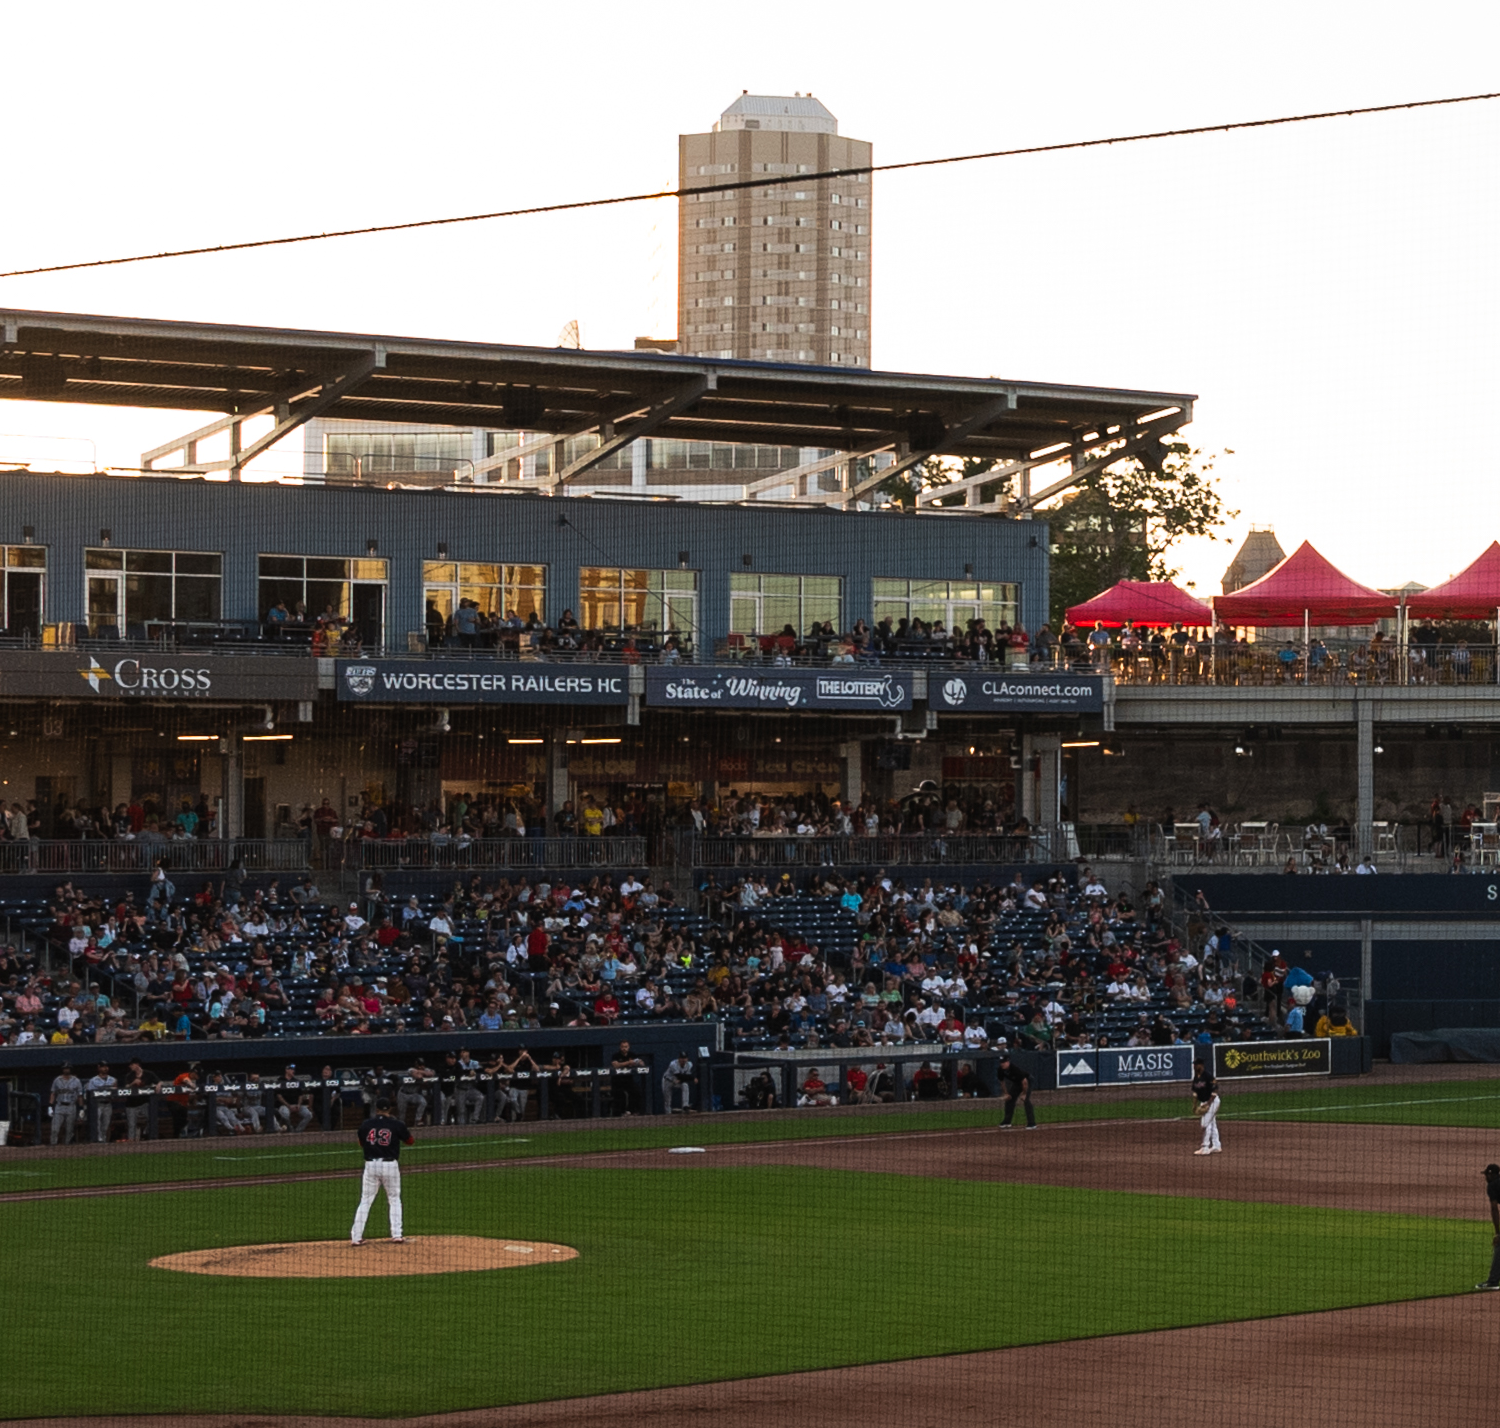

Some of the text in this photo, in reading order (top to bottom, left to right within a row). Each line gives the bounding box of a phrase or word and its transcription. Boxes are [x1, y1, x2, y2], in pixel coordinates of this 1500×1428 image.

[382, 673, 622, 693] WORCESTER RAILERS HC
[665, 678, 801, 706] State of Winning
[820, 680, 886, 695] THE LOTTERY
[982, 681, 1093, 697] CLAconnect.com
[1117, 1053, 1174, 1072] MASIS
[1240, 1049, 1321, 1063] Southwick's Zoo
[365, 1128, 393, 1147] 43
